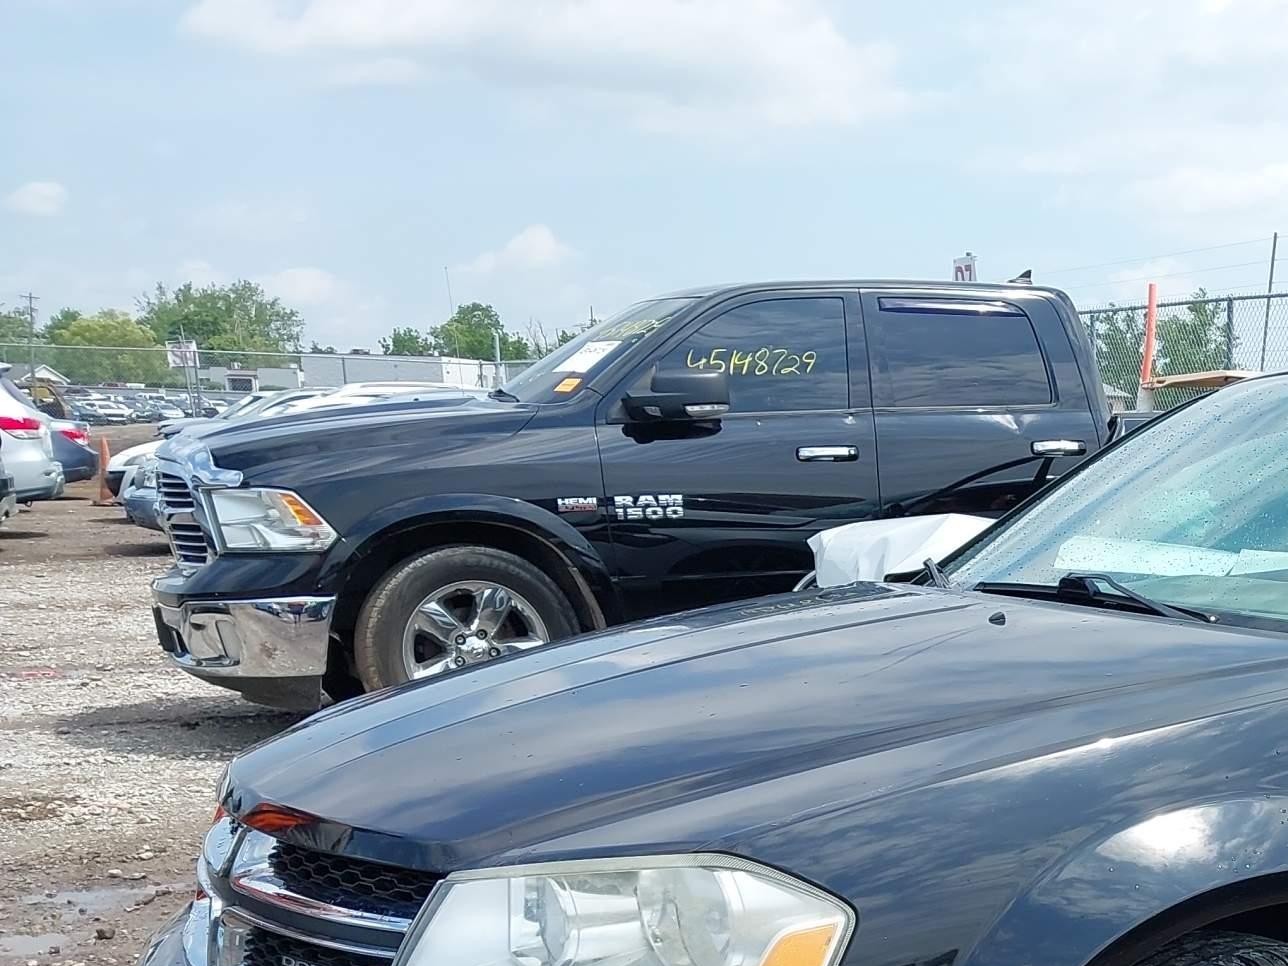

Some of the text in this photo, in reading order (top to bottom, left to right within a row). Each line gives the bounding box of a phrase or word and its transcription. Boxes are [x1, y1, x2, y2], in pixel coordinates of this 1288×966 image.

[687, 347, 817, 375] 45148729
[556, 497, 597, 505] HEMI
[613, 494, 684, 507] RAM
[615, 507, 684, 520] 1500
